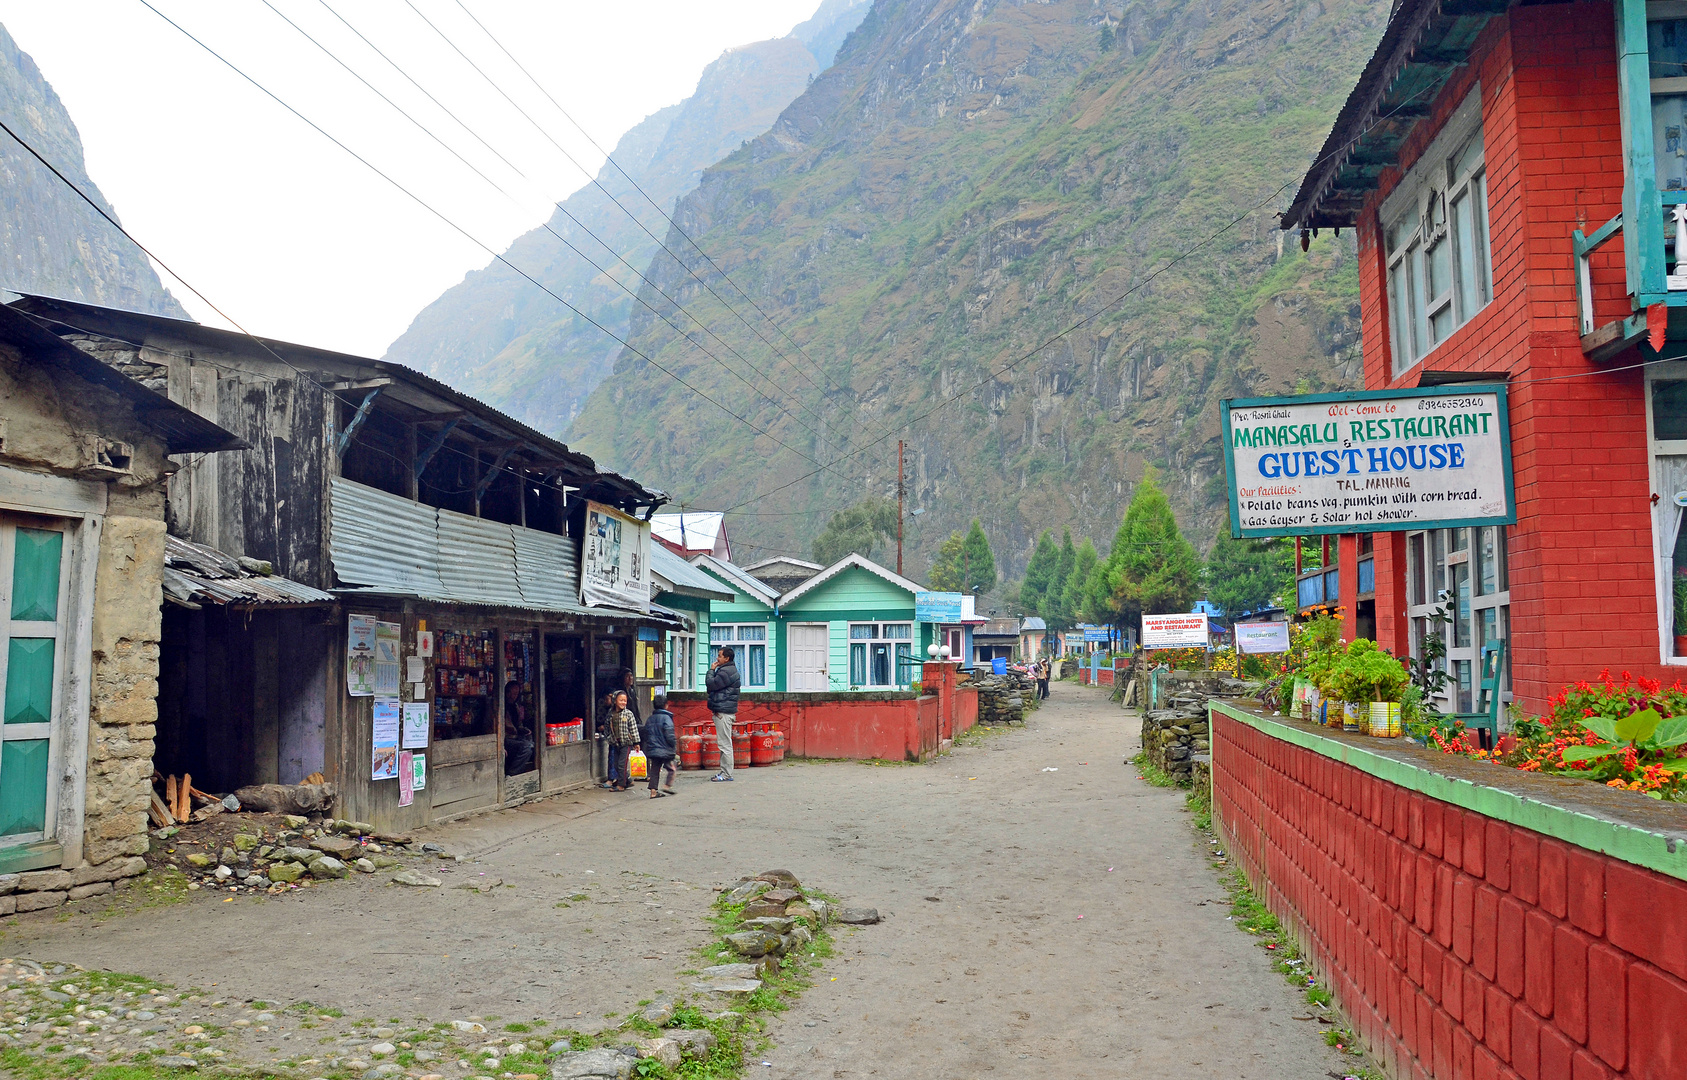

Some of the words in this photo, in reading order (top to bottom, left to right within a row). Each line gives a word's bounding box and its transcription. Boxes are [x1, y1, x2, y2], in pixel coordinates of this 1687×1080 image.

[1385, 402, 1397, 413] to
[1234, 423, 1338, 448] MANASALU
[1350, 412, 1492, 442] RESTAURANT
[1343, 439, 1352, 448] &
[1258, 449, 1363, 478] GUEST
[1366, 443, 1465, 472] HOUSE
[1240, 487, 1256, 496] Our
[1287, 498, 1318, 510] beans
[1392, 492, 1416, 504] with
[1421, 492, 1444, 502] corn
[1248, 516, 1267, 526] Gas
[1270, 515, 1305, 527] Geyser
[1310, 514, 1318, 523] &
[1322, 512, 1351, 522] Solar
[1356, 510, 1373, 520] hot
